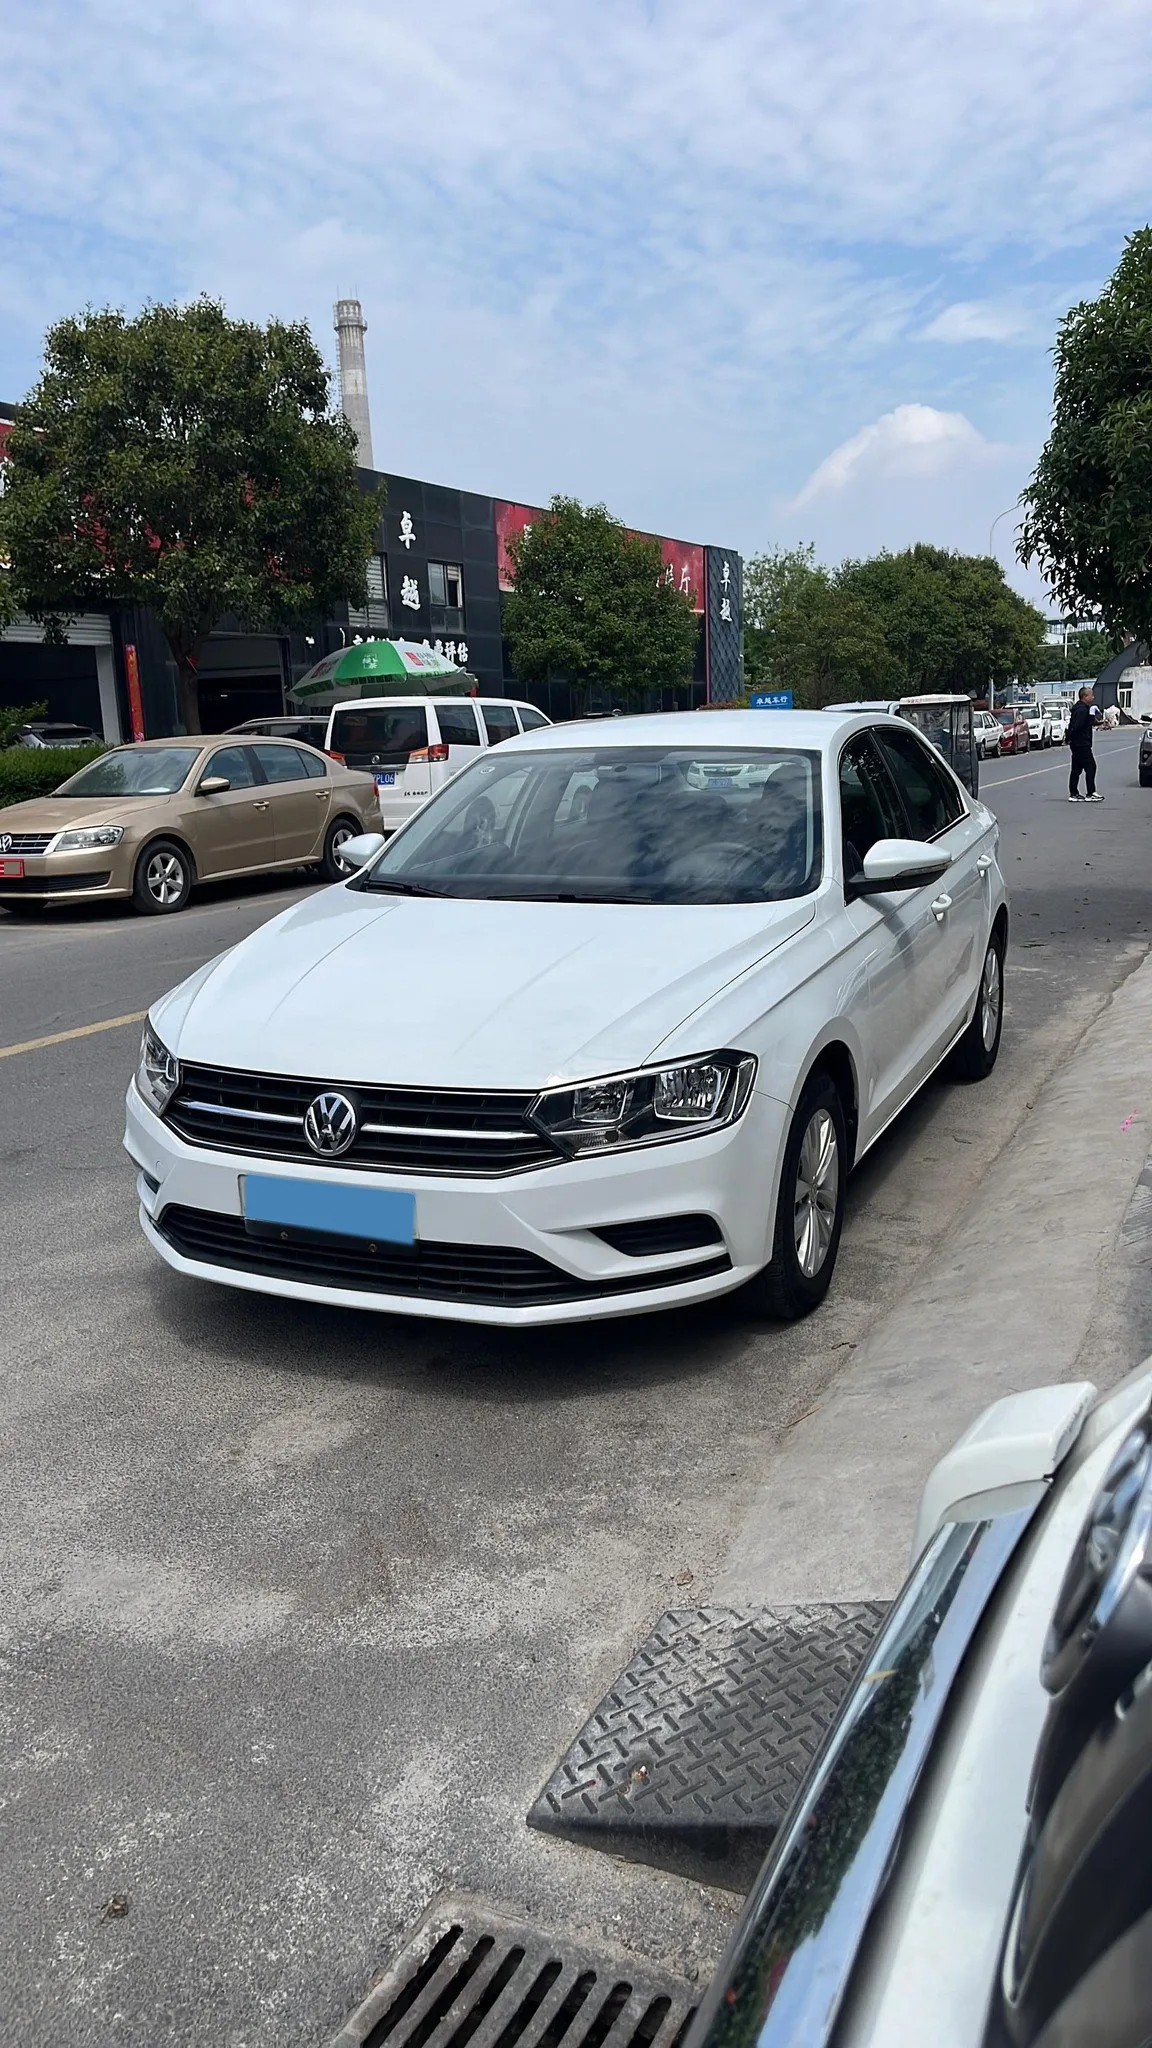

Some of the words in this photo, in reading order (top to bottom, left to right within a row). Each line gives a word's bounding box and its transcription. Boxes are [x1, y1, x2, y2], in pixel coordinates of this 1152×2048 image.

[399, 511, 420, 610] 卓越
[720, 561, 733, 621] 卓越
[374, 774, 394, 784] PL06
